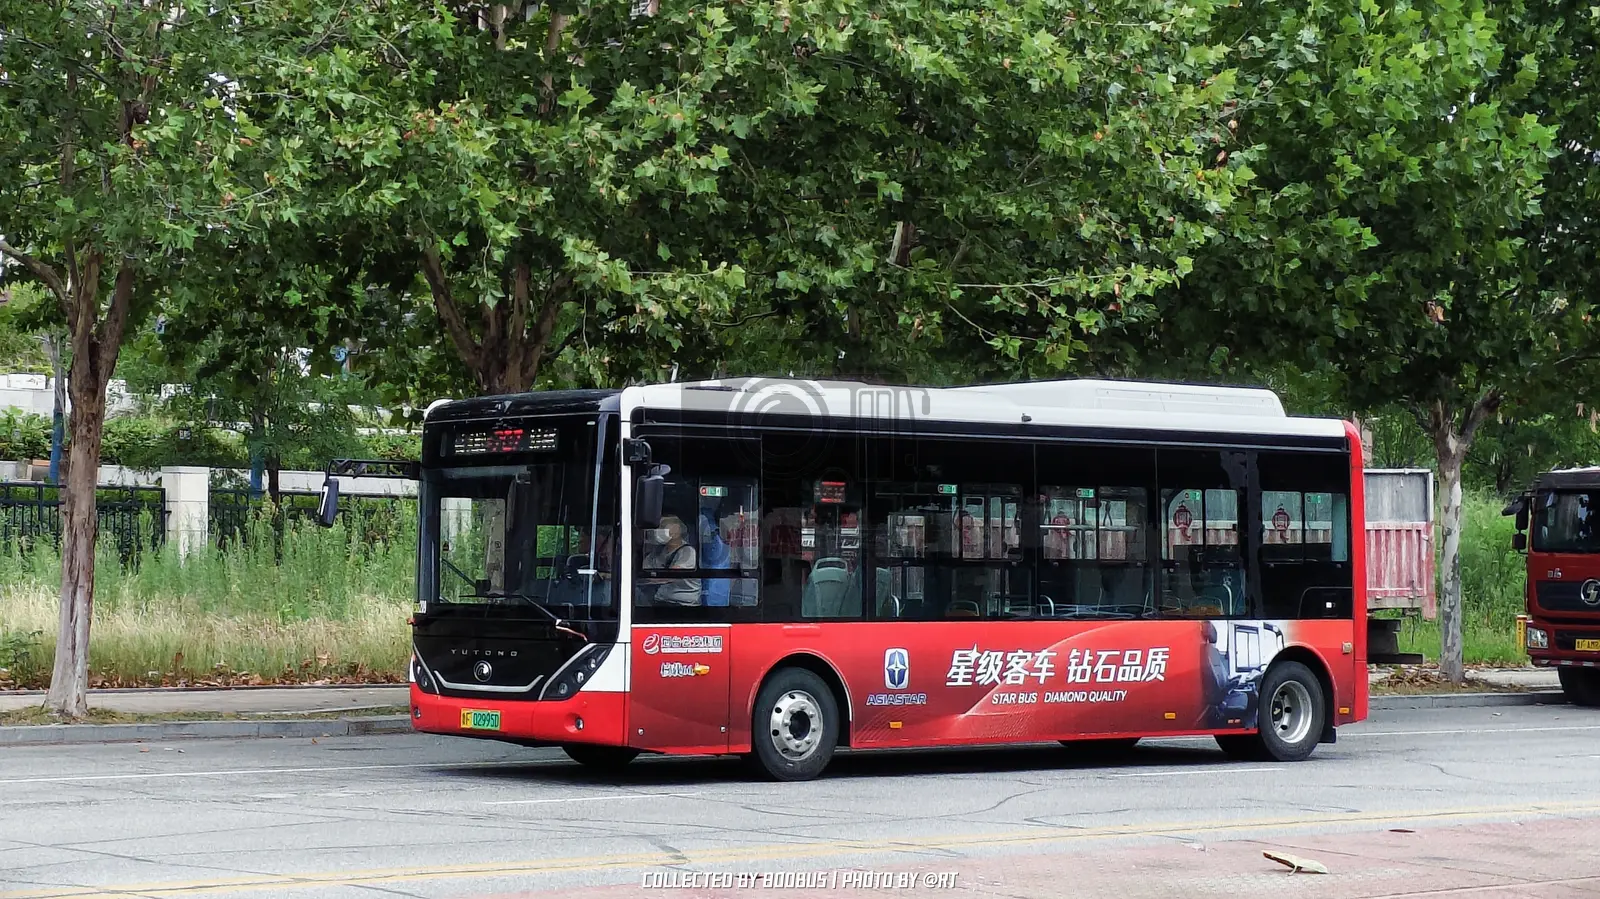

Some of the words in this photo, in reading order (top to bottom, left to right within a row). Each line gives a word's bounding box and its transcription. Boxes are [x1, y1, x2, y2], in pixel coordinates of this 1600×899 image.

[451, 649, 517, 657] YUTONG
[945, 644, 1057, 686] 星级客车
[1067, 647, 1170, 684] 钻石品质
[866, 693, 926, 706] ASIASTAR
[991, 693, 1016, 705] STAR
[1018, 692, 1038, 704] BUS
[1044, 691, 1087, 703] DIAMOND
[1088, 690, 1128, 702] QUALITY
